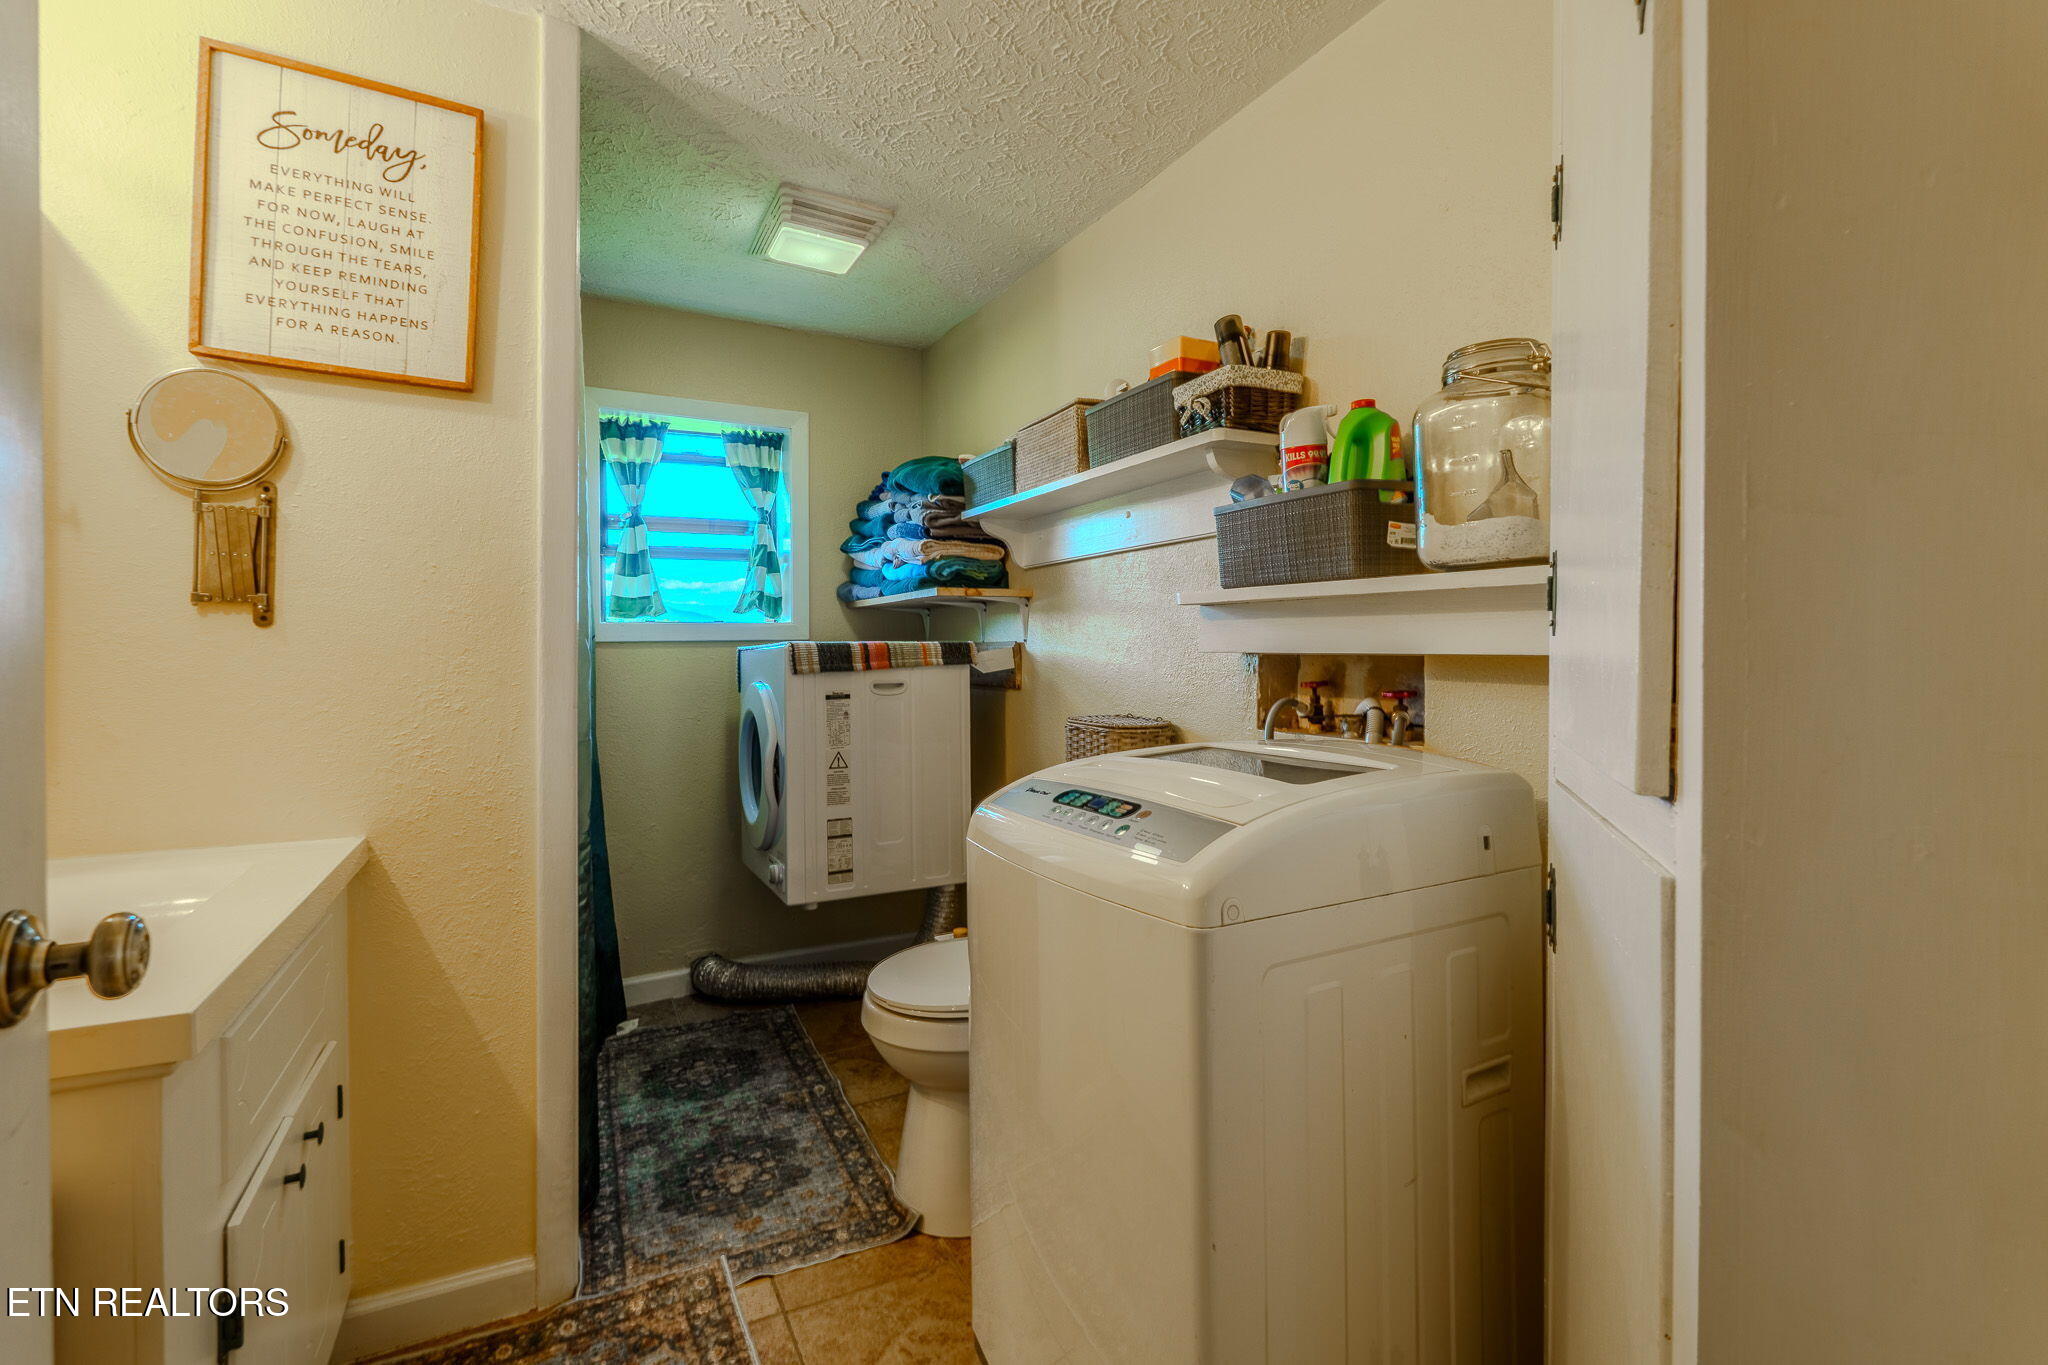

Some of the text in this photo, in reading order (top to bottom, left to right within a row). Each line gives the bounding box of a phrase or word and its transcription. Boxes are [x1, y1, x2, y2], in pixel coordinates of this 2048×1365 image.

[256, 110, 427, 183] Someday,
[249, 178, 433, 225] MAKE PERFECT SENSE.
[269, 163, 416, 203] EVERYTHING WILL
[243, 215, 435, 261] THE CONFUSION, SMILE
[256, 199, 425, 240] FOR NOW, LAUGH AT
[248, 256, 428, 296] AND KEEP REMINDING
[250, 236, 428, 279] THROUGH THE TEARS,
[244, 292, 429, 331] EVERYTHING HAPPENS
[273, 278, 405, 310] YOURSELF THAT
[275, 317, 400, 345] FOR A REASON.
[1286, 451, 1306, 462] KILLS
